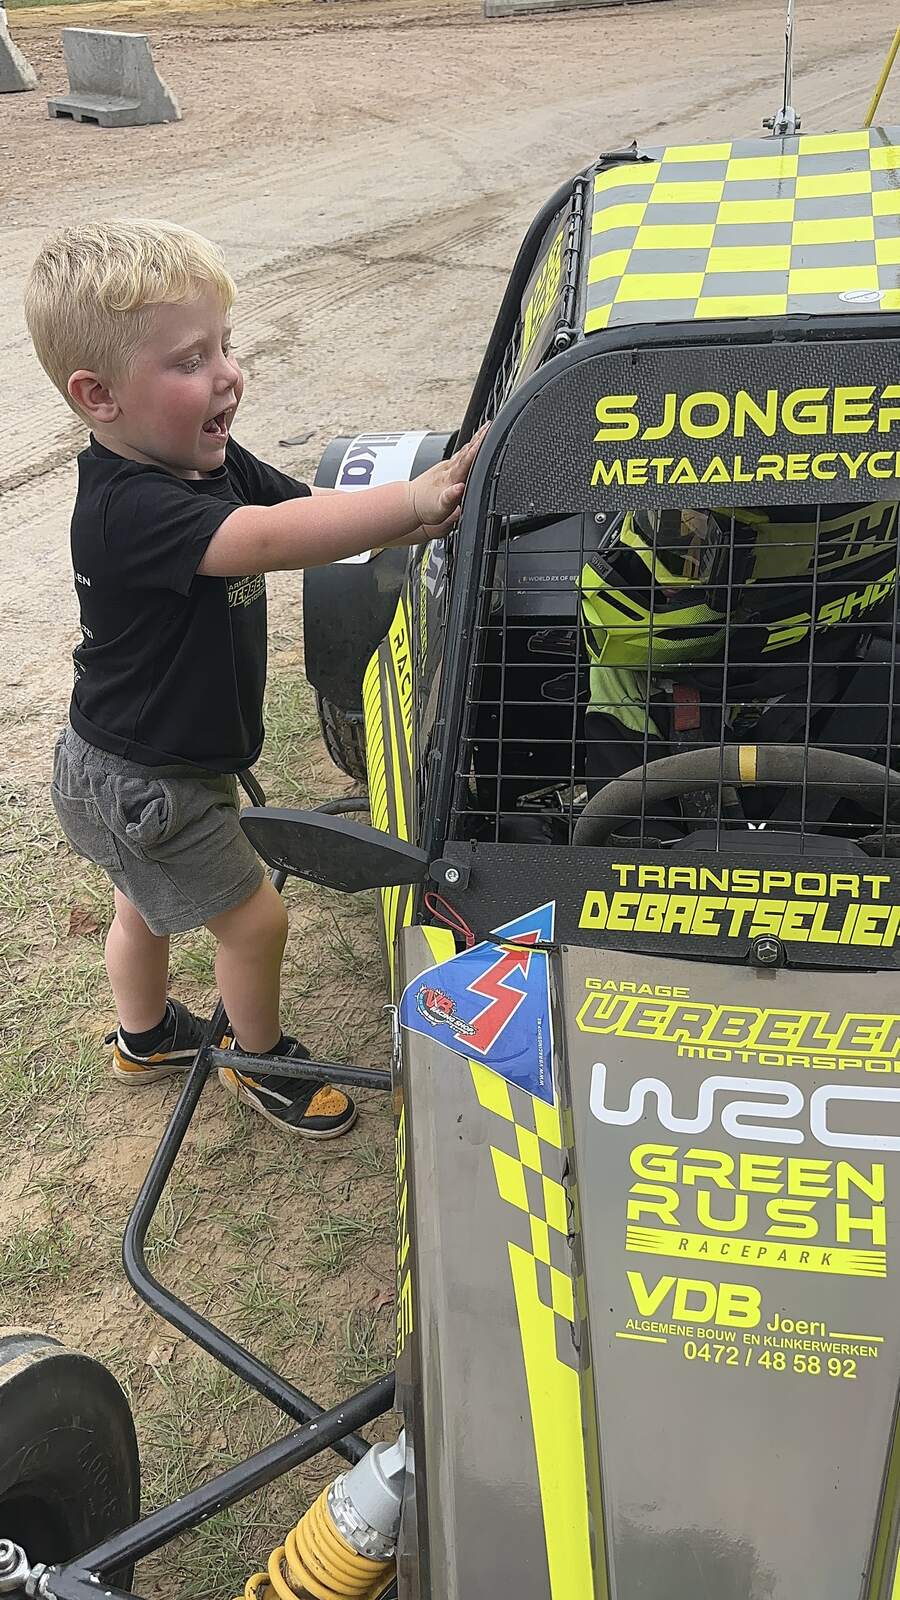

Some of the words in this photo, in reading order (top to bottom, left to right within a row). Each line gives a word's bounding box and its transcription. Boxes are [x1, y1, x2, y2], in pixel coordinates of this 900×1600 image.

[590, 451, 900, 486] METAALRECYC
[611, 864, 890, 899] TRANSPORT
[585, 977, 690, 999] GARAGE
[677, 1045, 900, 1073] MOTORSPO
[589, 1063, 900, 1152] WRC
[629, 1143, 885, 1202] GREEN
[626, 1182, 887, 1246] RUSH
[678, 1237, 832, 1266] RACEPARK
[626, 1271, 762, 1329] VDB
[625, 1318, 694, 1337] ALGEMENE
[697, 1328, 736, 1342] BOUW
[743, 1334, 761, 1345] EN
[763, 1336, 878, 1358] KLINKERWERKEN
[766, 1313, 826, 1337] Joeri
[684, 1341, 739, 1365] 0472
[758, 1350, 786, 1371] 48
[793, 1354, 821, 1375] 58
[828, 1358, 857, 1379] 92
